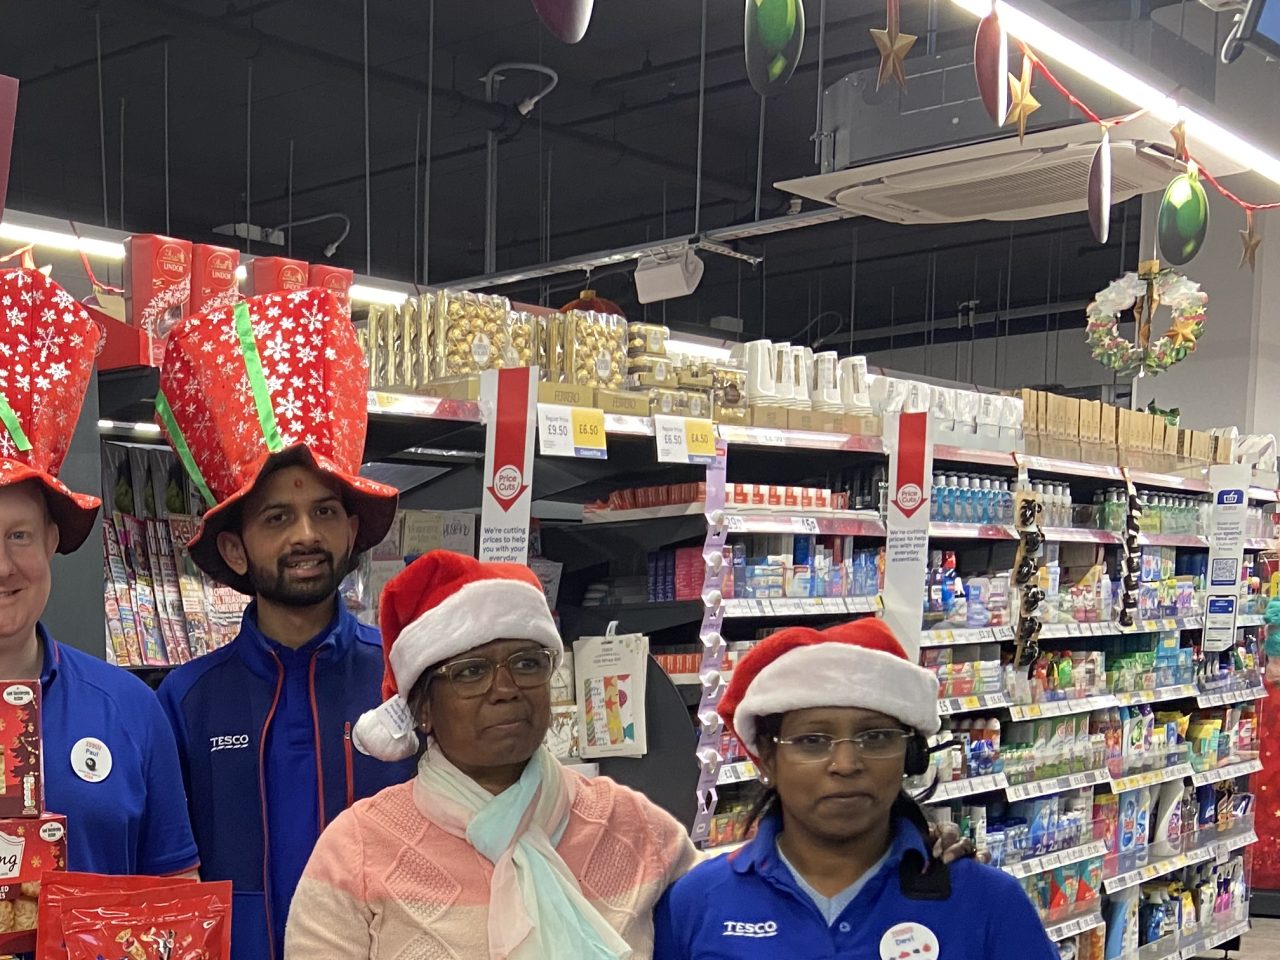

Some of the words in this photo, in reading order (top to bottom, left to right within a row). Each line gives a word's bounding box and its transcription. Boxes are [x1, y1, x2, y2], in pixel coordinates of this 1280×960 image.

[163, 262, 183, 273] LINDOR
[211, 271, 232, 280] LINDOR
[555, 390, 579, 403] FERRERO
[548, 424, 568, 436] £9.50
[579, 424, 599, 436] £6.50
[664, 434, 682, 444] £6.50
[691, 433, 708, 444] £4.50
[499, 474, 517, 482] Price
[499, 483, 516, 491] Cuts
[503, 527, 526, 535] cutting
[483, 536, 502, 544] prices
[512, 536, 526, 544] help
[489, 555, 517, 563] everyday
[210, 734, 249, 747] TESCO
[85, 748, 99, 757] Paul
[723, 920, 778, 934] TESCO
